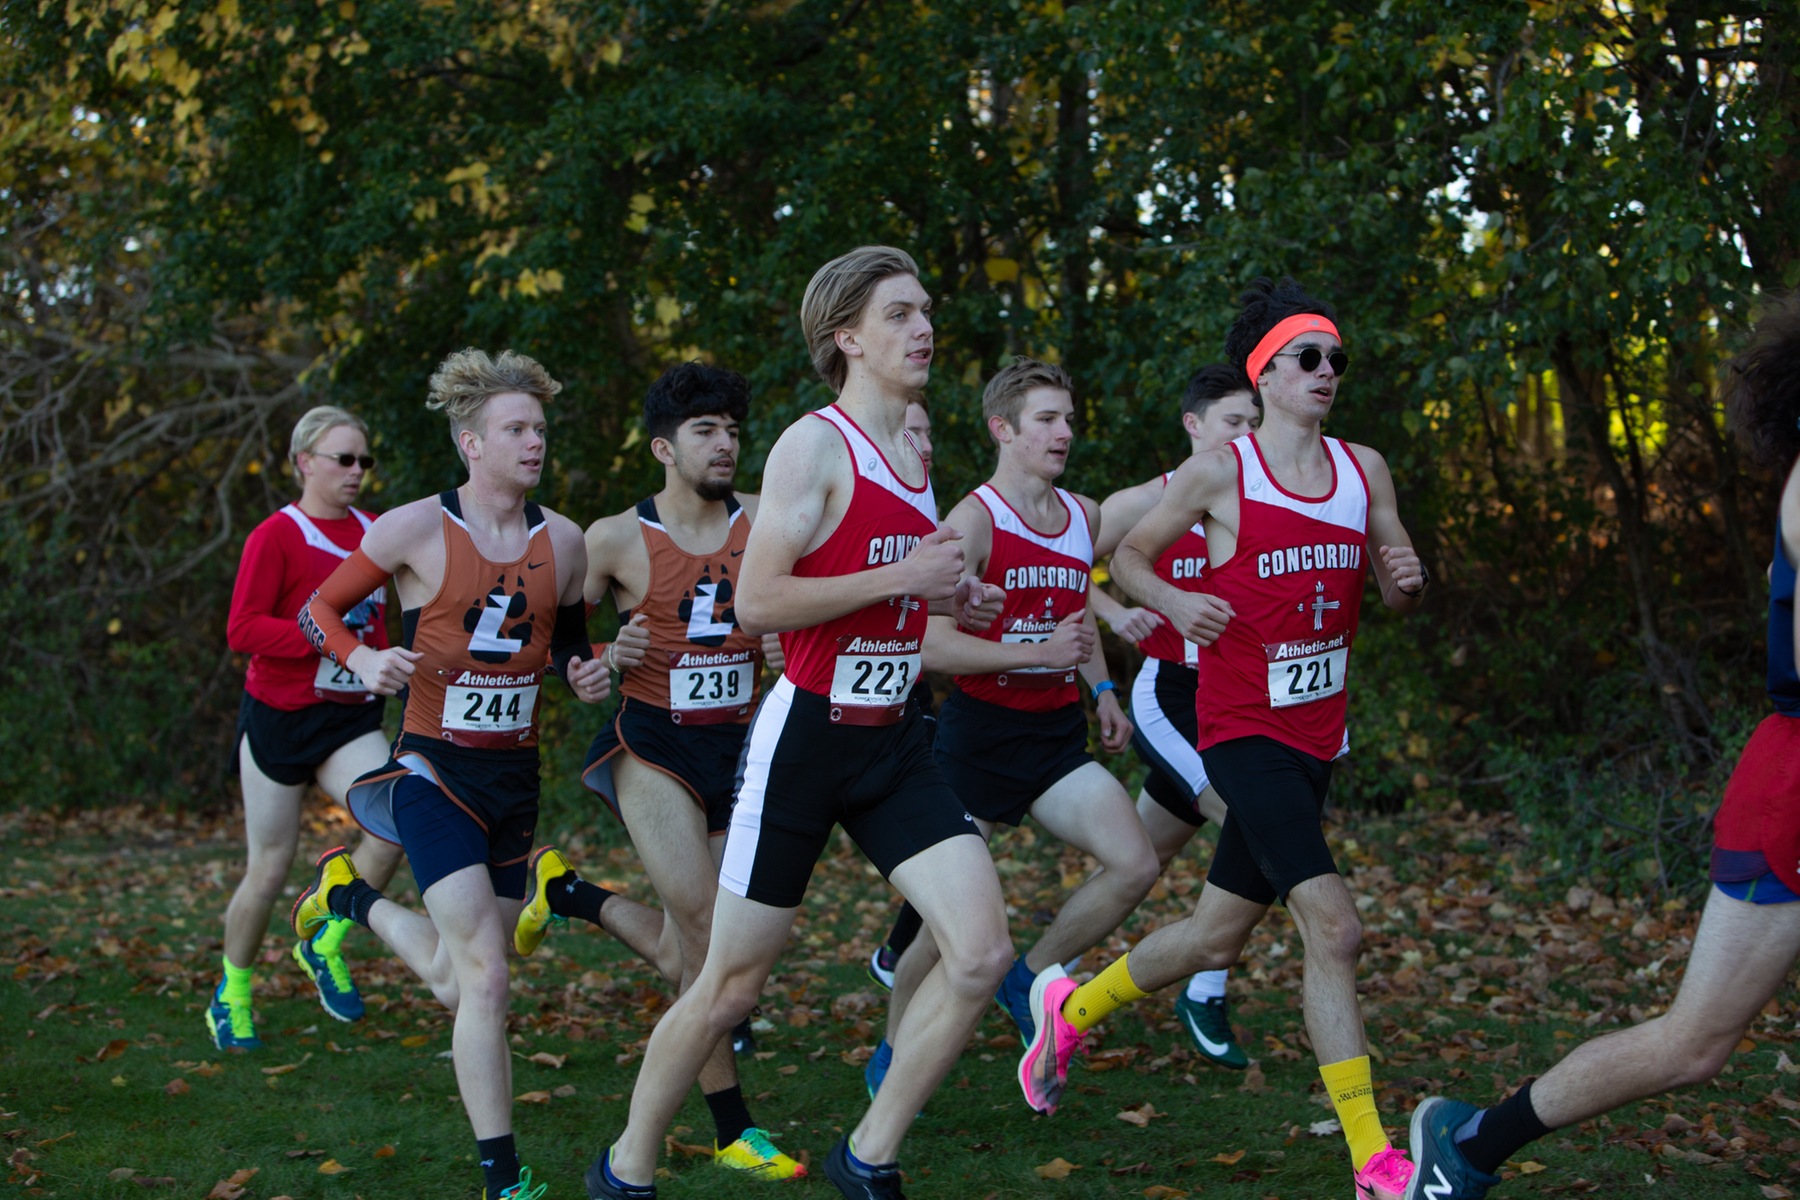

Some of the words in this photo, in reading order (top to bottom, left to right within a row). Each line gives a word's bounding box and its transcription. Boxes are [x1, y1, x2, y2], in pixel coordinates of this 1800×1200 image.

[1257, 543, 1361, 580] CONCORDIA
[1004, 565, 1088, 594] CONCORDIA
[1008, 618, 1058, 633] Athletic
[676, 650, 750, 668] Athletic.net
[844, 636, 919, 653] Athletic.net
[1274, 634, 1344, 660] Athletic.net
[454, 670, 536, 687] Athletic.net
[688, 669, 740, 701] 239
[851, 660, 910, 696] 223
[1286, 657, 1333, 696] 221
[463, 691, 522, 723] 244
